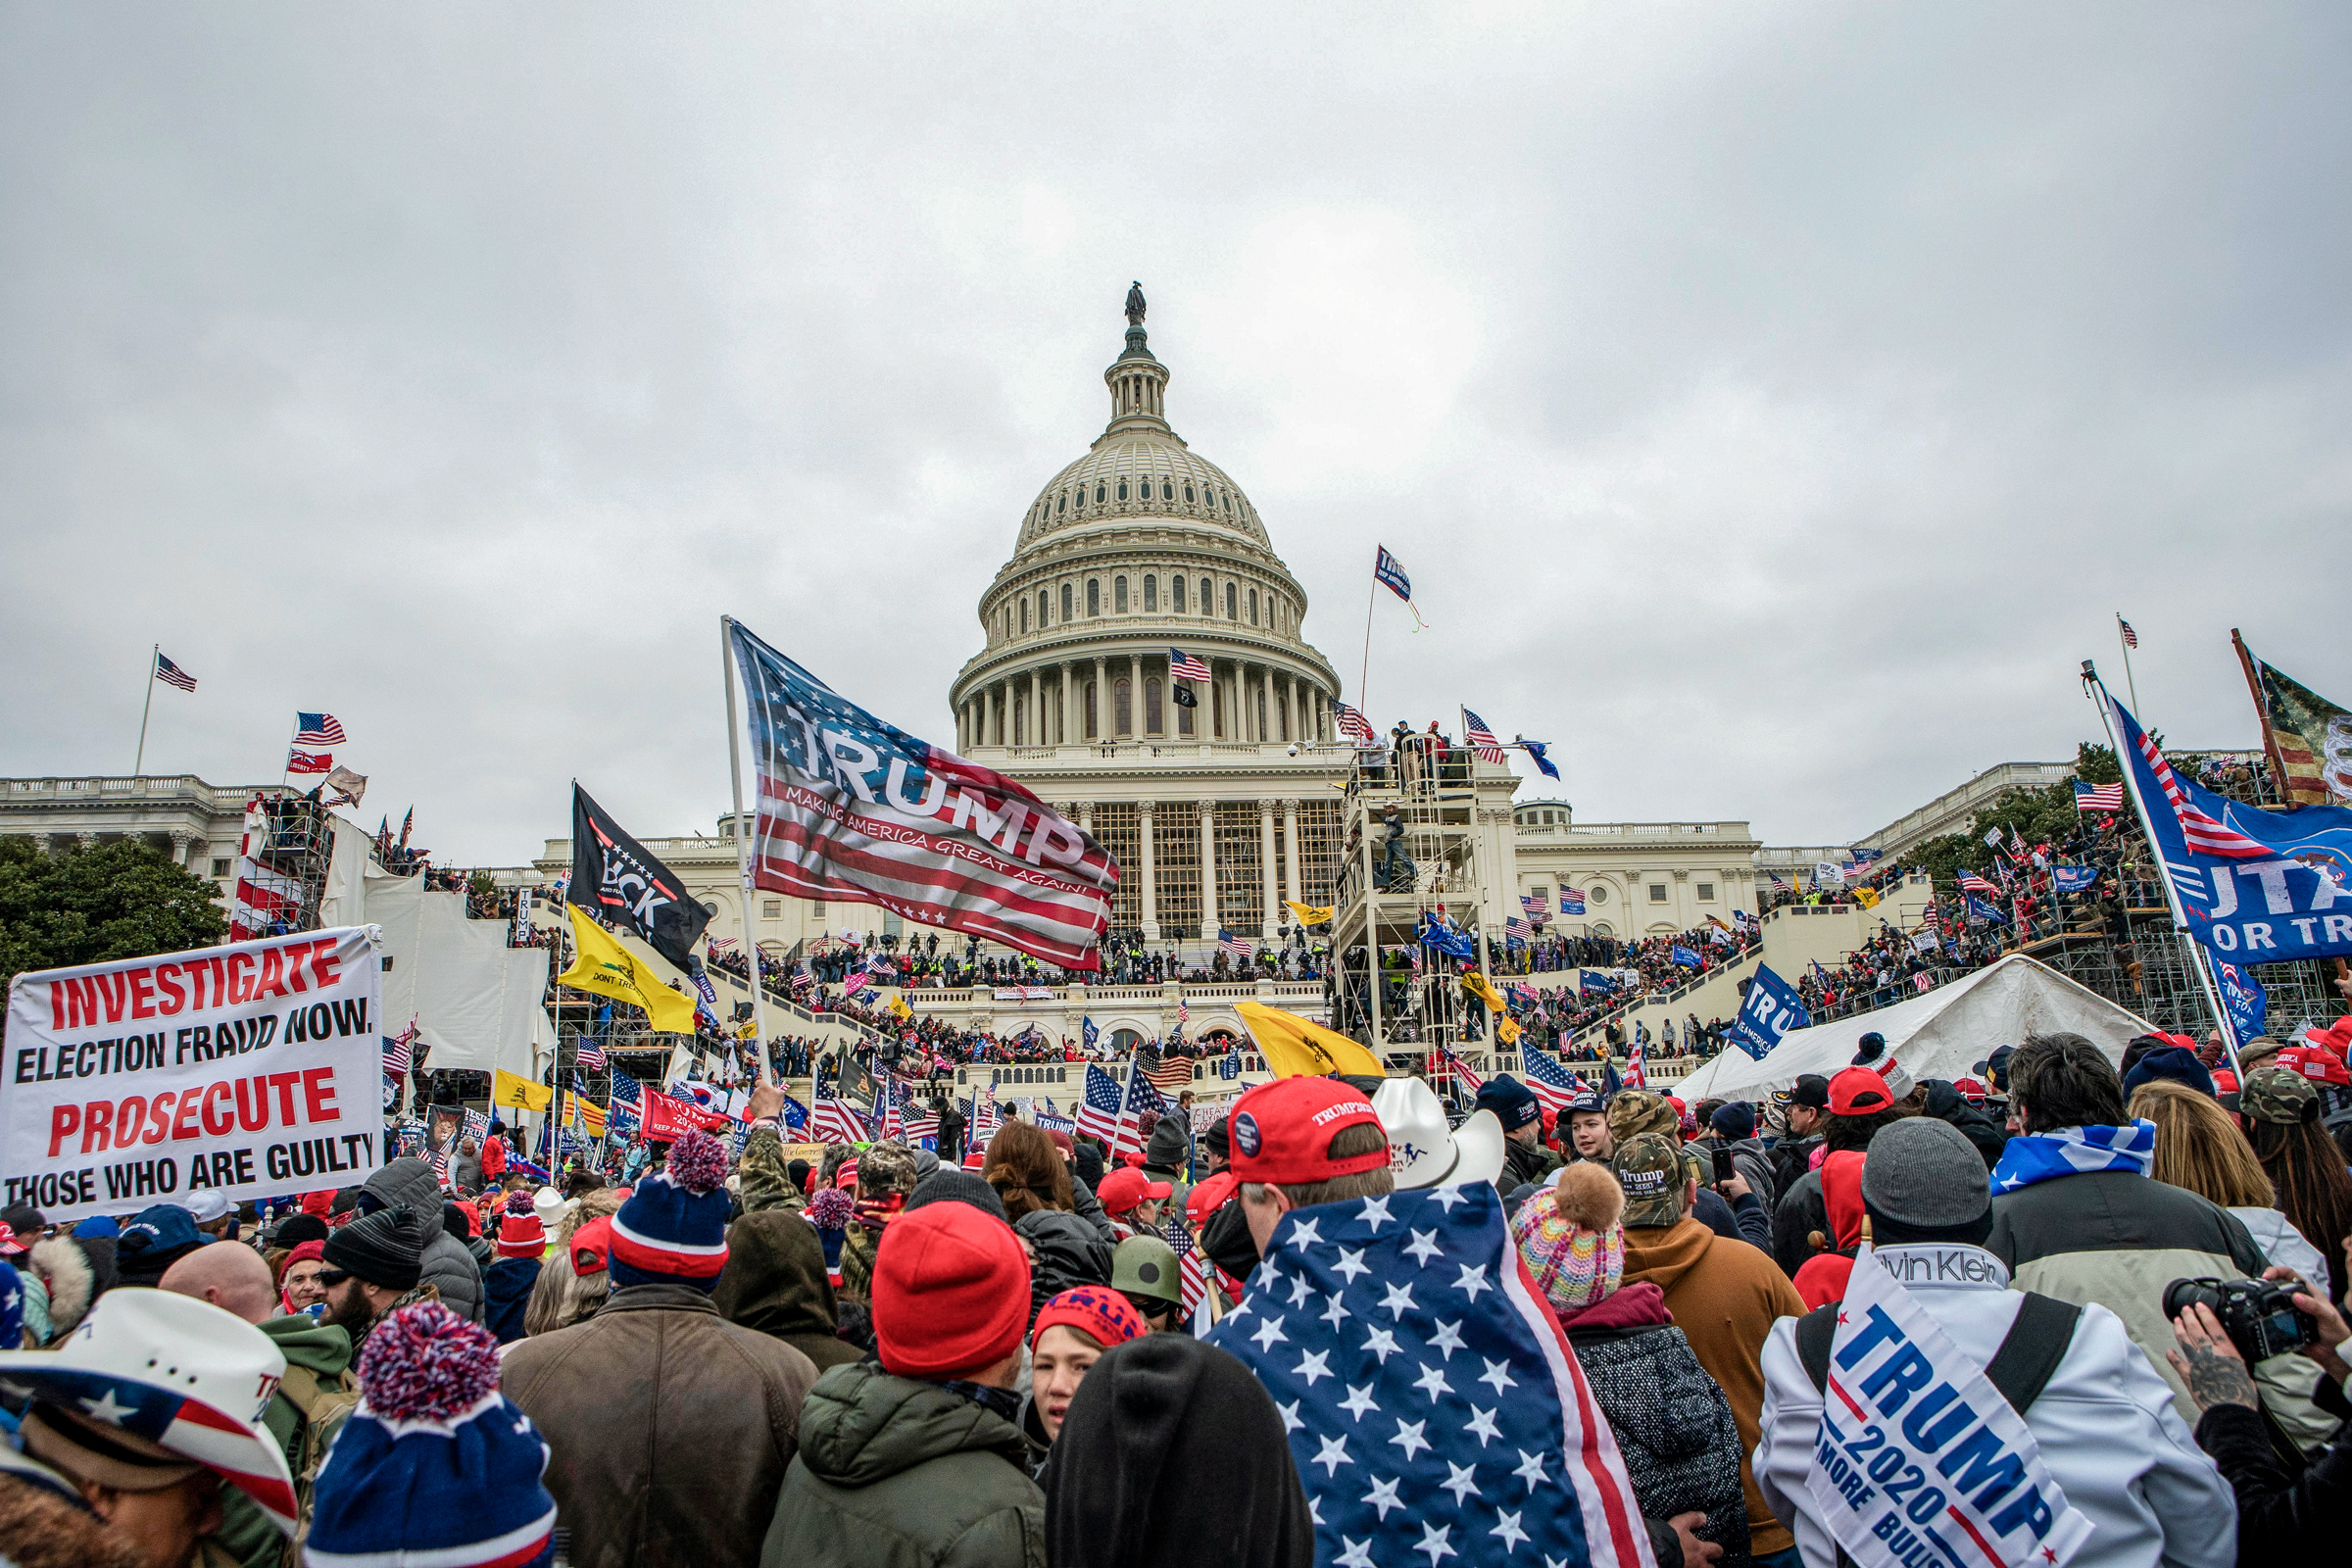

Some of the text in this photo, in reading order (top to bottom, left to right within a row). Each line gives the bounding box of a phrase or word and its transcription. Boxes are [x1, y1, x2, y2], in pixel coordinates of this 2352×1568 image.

[290, 761, 311, 772] LIBERTY
[786, 705, 1085, 866] TRUMP
[786, 786, 1088, 895] MAKING AMERICA GREAT AGAIN!
[518, 890, 530, 941] TRUMP
[2212, 922, 2278, 952] OR
[1677, 948, 1701, 958] TRUMP
[50, 937, 342, 1030] INVESTIGATE
[697, 971, 716, 1003] TRUMP
[1583, 982, 1608, 992] LIBERTY
[1746, 982, 1794, 1037] TRU
[15, 997, 372, 1084] ELECTION FRAUD NOW.
[47, 1066, 341, 1158] PROSECUTE
[1037, 1117, 1074, 1135] TRUMP
[1517, 1101, 1536, 1114] Trump
[5, 1133, 373, 1207] THOSE WHO ARE GUILTY
[1619, 1169, 1665, 1184] Trump
[142, 1222, 161, 1236] TRUMP
[1936, 1250, 1996, 1284] Klein
[1835, 1302, 2053, 1542] TRUMP
[1815, 1444, 1877, 1511] MORE
[1844, 1424, 1947, 1525] 2020
